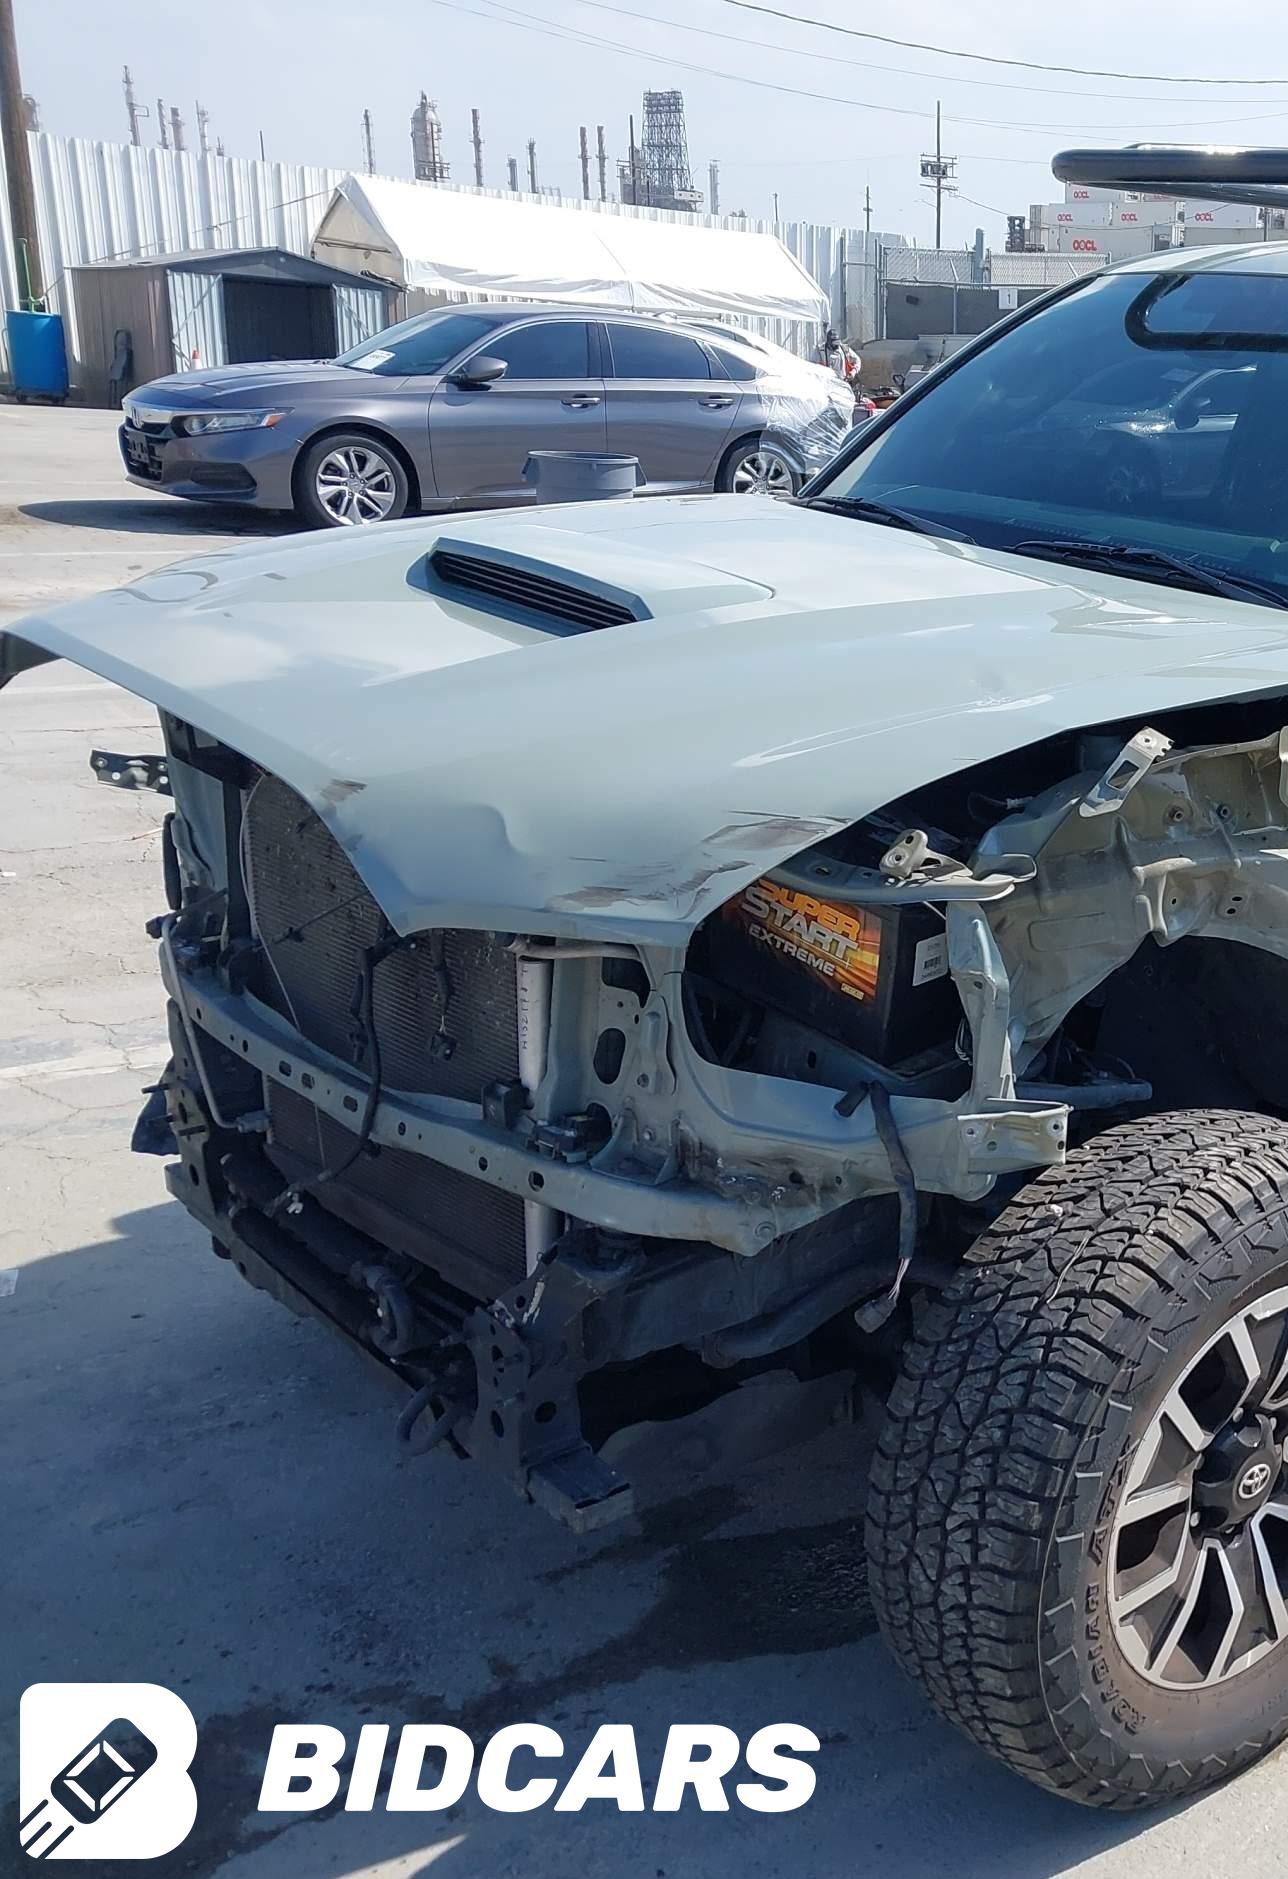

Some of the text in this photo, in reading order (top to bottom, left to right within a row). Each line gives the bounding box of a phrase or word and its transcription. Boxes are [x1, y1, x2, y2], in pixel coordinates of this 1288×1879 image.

[1072, 239, 1098, 252] OOCL
[740, 885, 860, 961] START
[757, 878, 862, 942] SUPER
[749, 922, 836, 978] EXTREME
